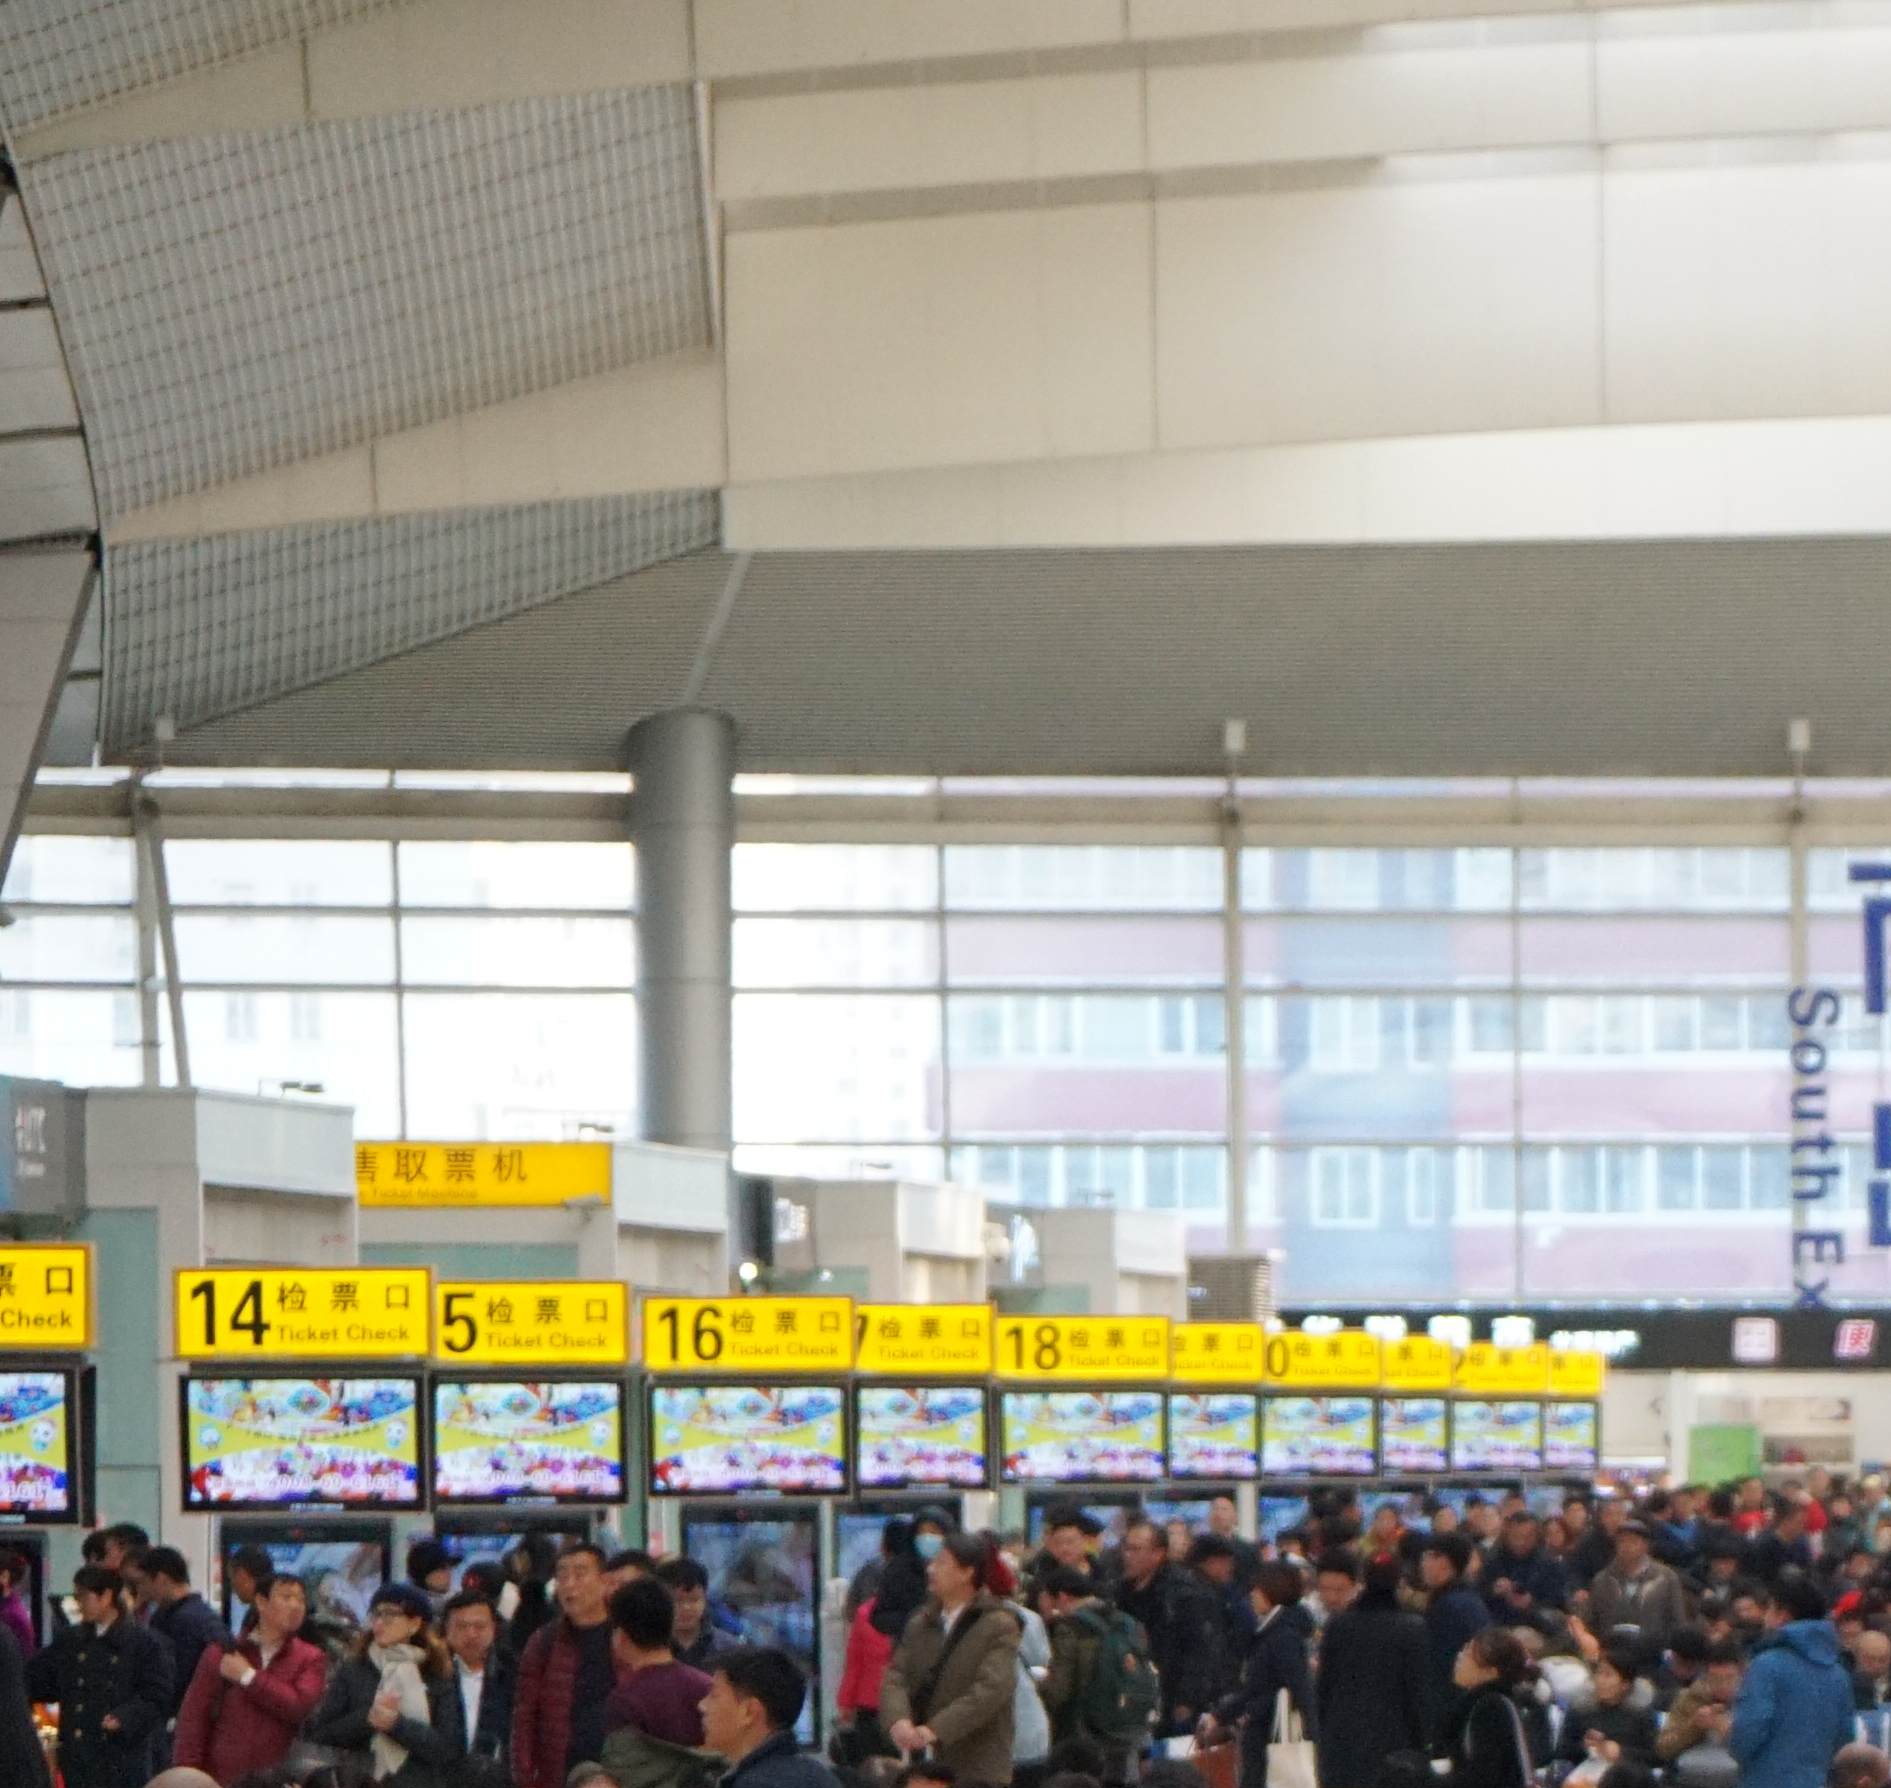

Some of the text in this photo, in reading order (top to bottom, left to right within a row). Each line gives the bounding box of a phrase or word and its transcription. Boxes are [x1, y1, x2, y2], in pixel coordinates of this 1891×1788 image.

[1787, 986, 1841, 1203] South
[191, 1279, 271, 1346] 14
[277, 1281, 411, 1312] 检票口
[277, 1324, 411, 1342] Ticket Check
[486, 1332, 607, 1349] Ticket Check
[658, 1305, 723, 1362] 16
[1005, 1321, 1062, 1370] 18
